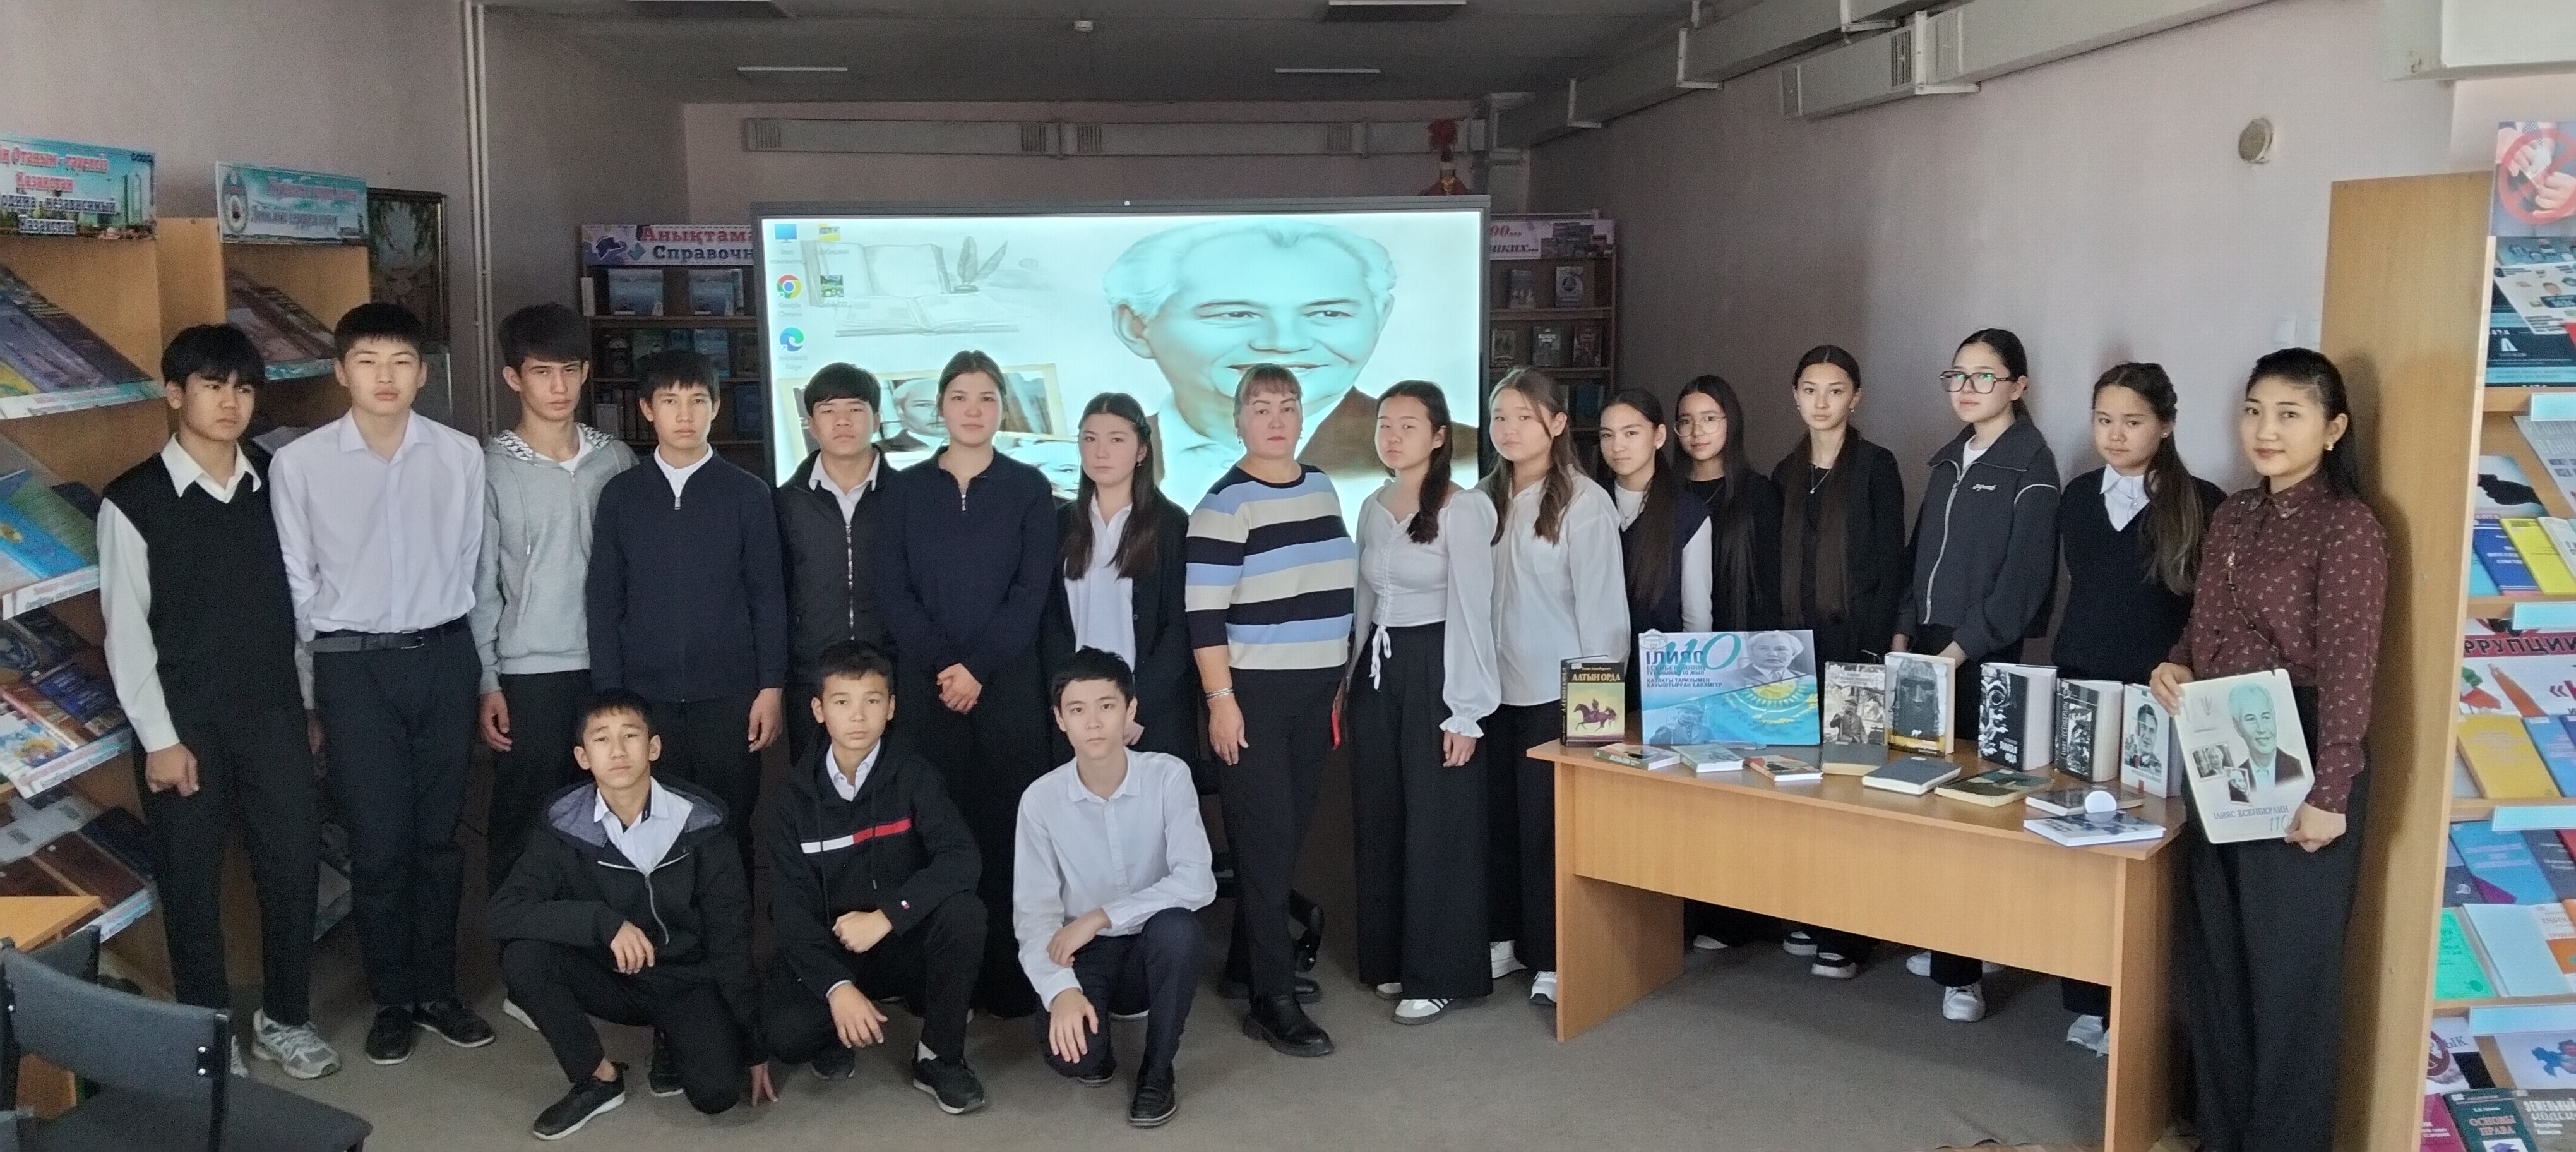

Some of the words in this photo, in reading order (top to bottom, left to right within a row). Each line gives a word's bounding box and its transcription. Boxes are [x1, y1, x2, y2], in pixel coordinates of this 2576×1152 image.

[1, 194, 36, 210] одина
[44, 196, 117, 213] независимый
[1646, 651, 1703, 664] ІЛИЯС
[1572, 673, 1599, 681] АЛТЫН
[1601, 673, 1621, 682] ОРДА
[2238, 805, 2289, 818] ЕСЕНБЕРЛИН
[2469, 1115, 2517, 1127] ОСНОВЫ
[2531, 1112, 2576, 1122] КОДЕК
[2479, 1125, 2517, 1136] ПРАВА
